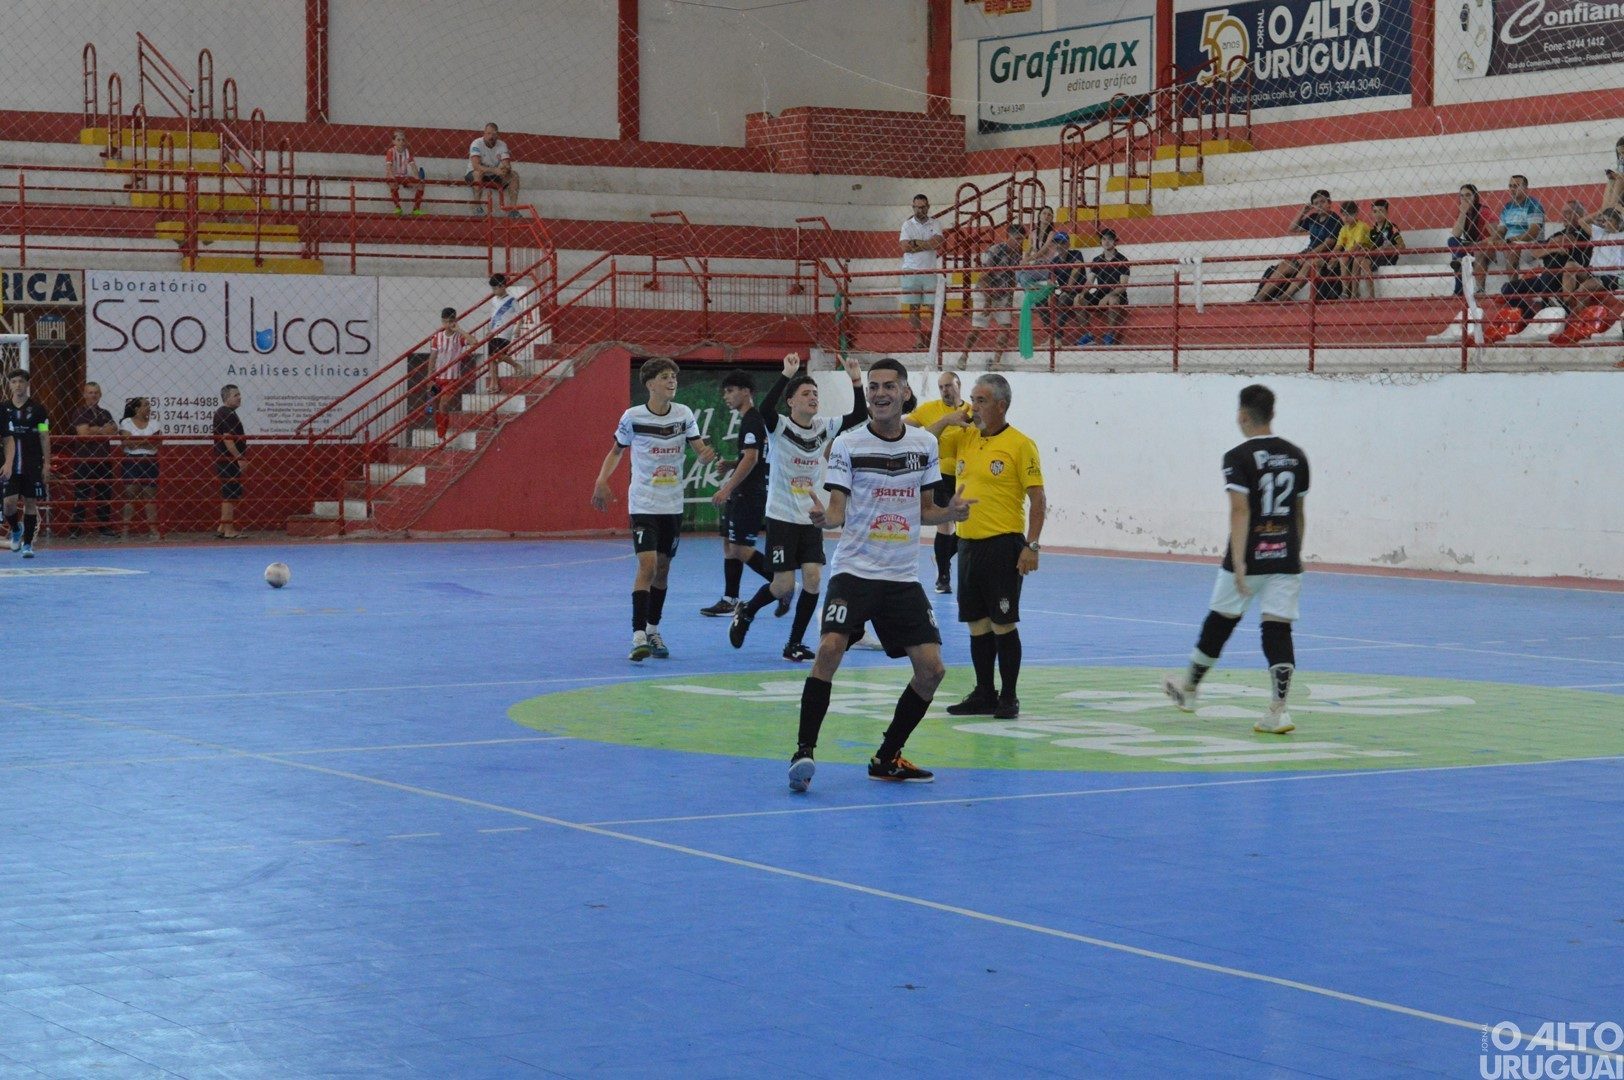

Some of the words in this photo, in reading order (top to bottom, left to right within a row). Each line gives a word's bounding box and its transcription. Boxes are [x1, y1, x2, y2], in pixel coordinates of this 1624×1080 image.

[1257, 8, 1265, 49] JORNAL
[1268, 5, 1293, 44] O
[1296, 0, 1381, 42] ALTO
[1500, 0, 1624, 45] Confian
[1222, 40, 1240, 50] anos
[1254, 35, 1381, 80] URUGUAI
[990, 39, 1139, 98] Grafimax
[1067, 78, 1101, 92] editora
[1103, 73, 1137, 91] gráfica
[92, 277, 207, 293] Laboratório
[92, 299, 207, 353] São
[225, 281, 371, 355] Lucas
[227, 364, 298, 377] Análises
[305, 364, 369, 377] clínicas
[164, 397, 219, 407] 3744-4988
[164, 411, 216, 421] 3744-134
[872, 487, 915, 498] Barril
[1259, 471, 1295, 516] 12
[636, 531, 644, 544] 7
[772, 550, 785, 563] 21
[825, 605, 847, 623] 20
